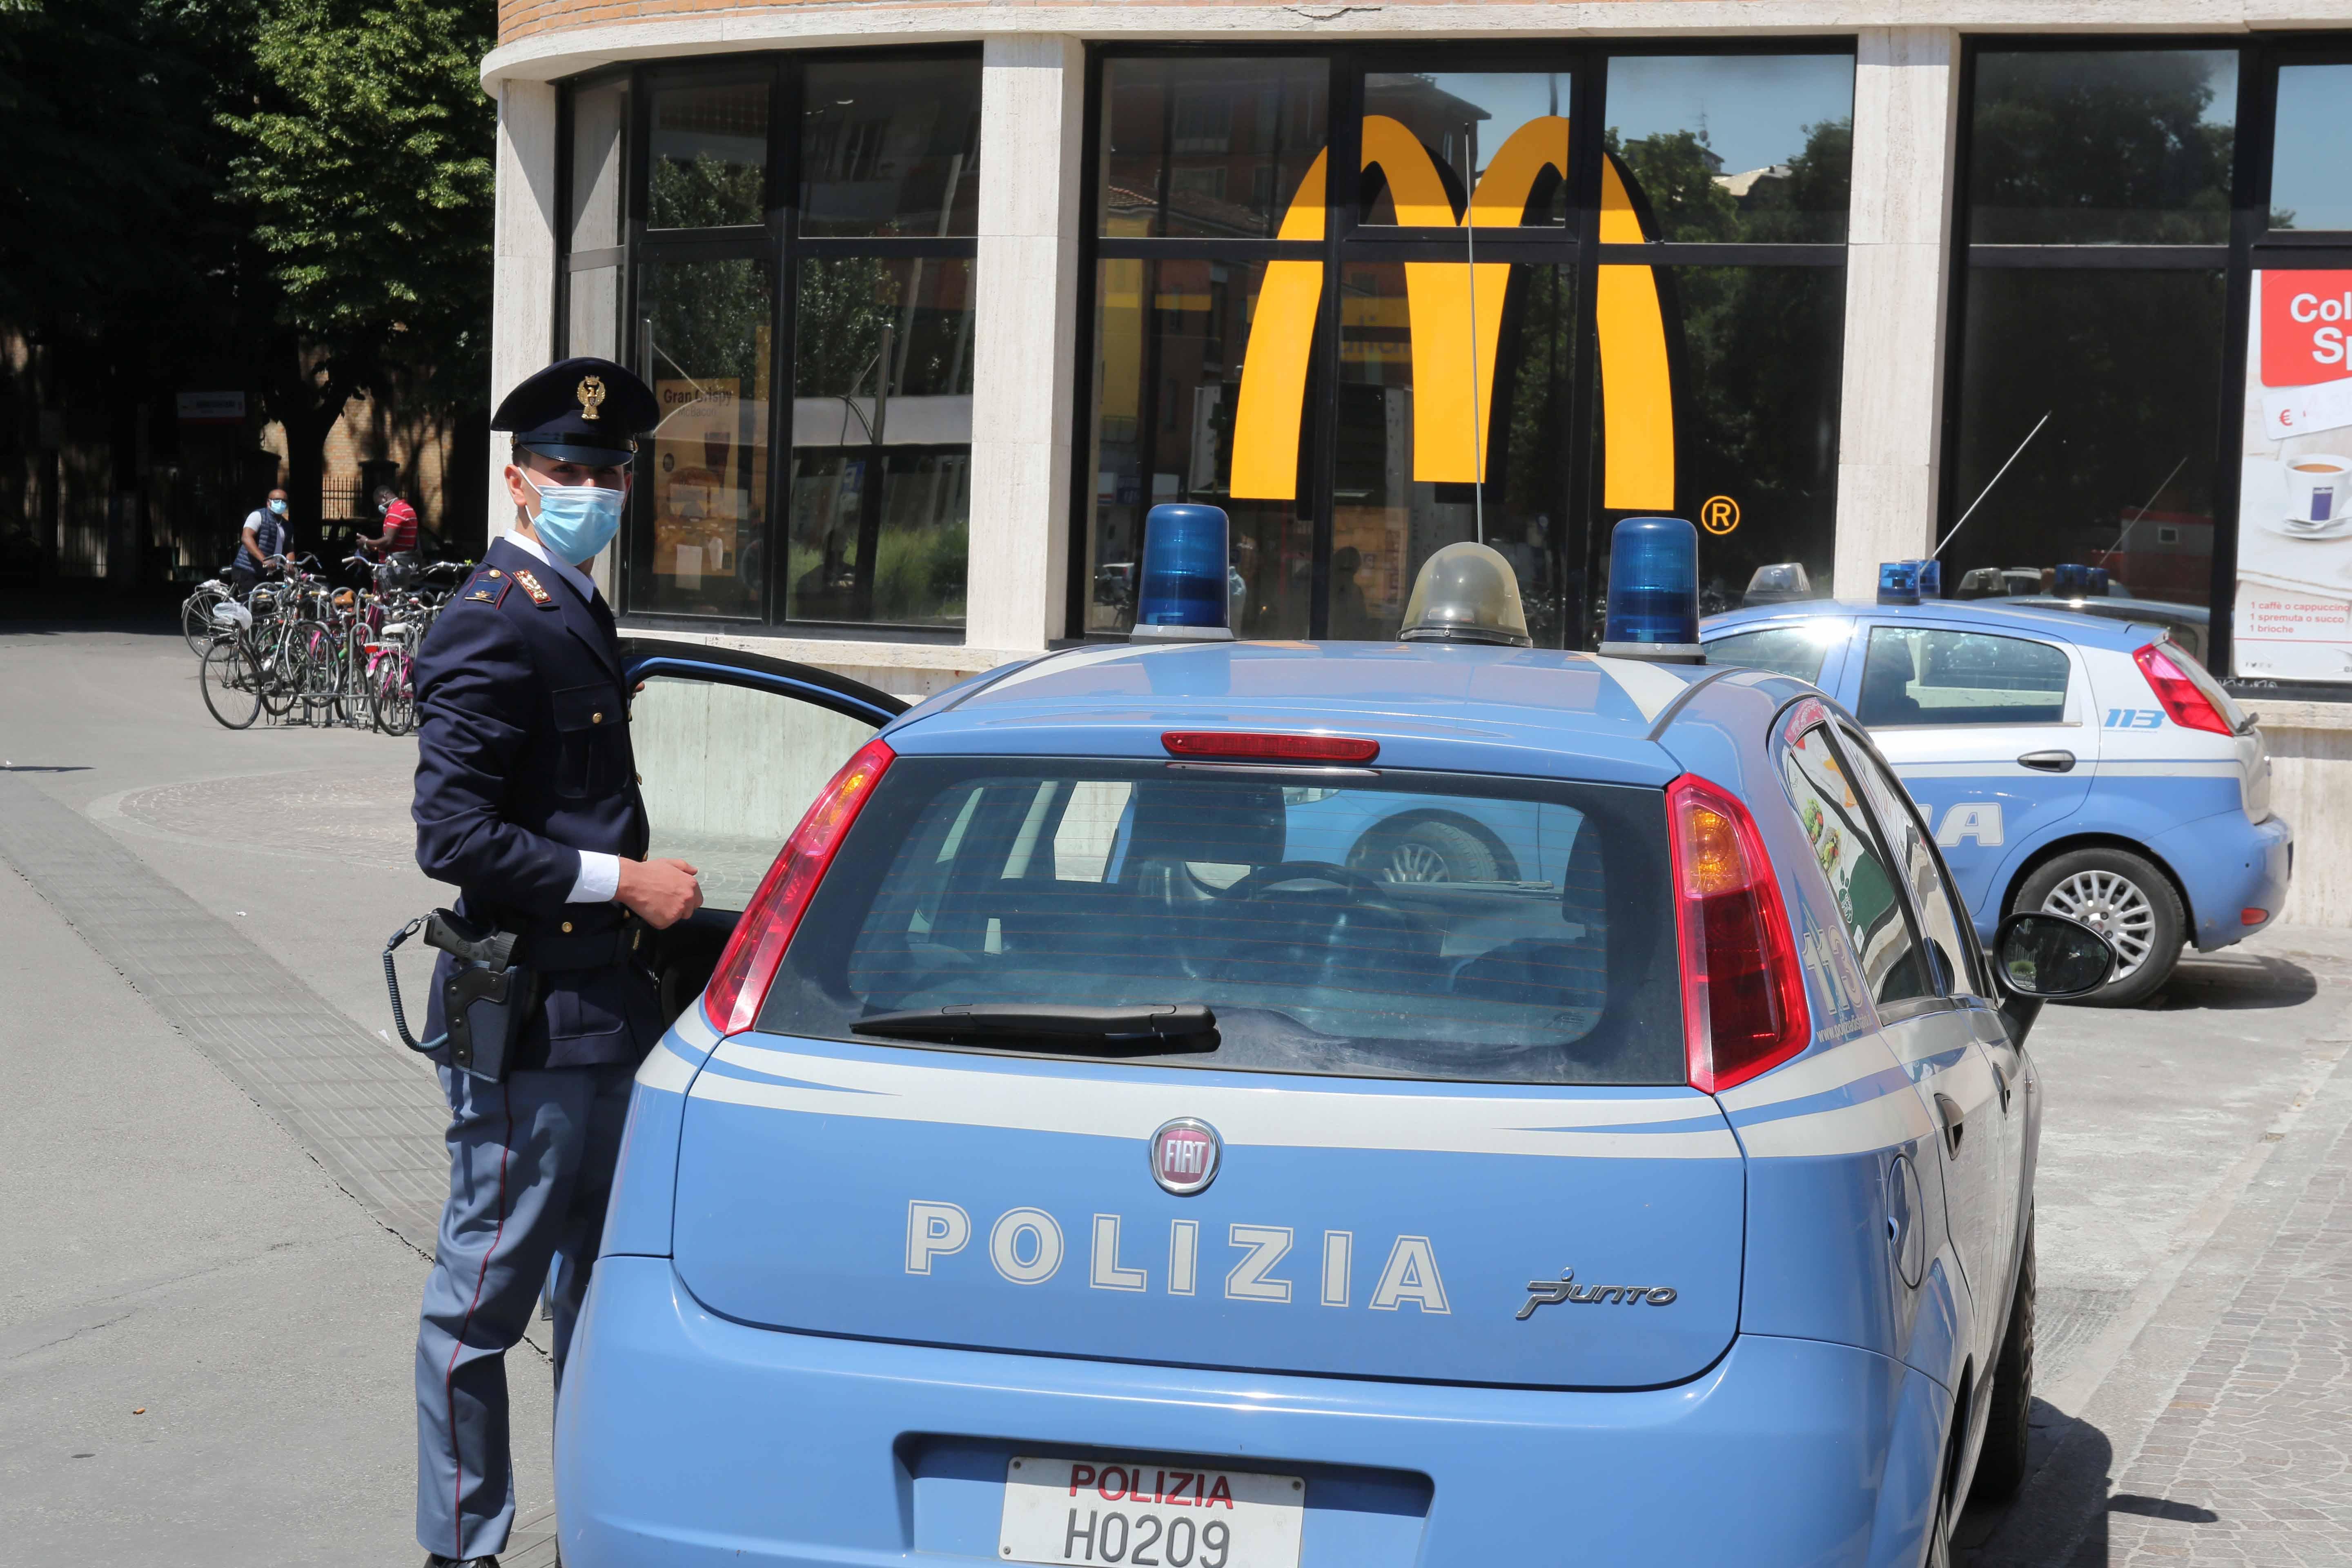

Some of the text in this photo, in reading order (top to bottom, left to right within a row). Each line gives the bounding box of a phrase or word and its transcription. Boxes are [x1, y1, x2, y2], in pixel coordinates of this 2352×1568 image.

[2290, 292, 2352, 323] Col
[2312, 326, 2352, 371] S
[664, 387, 732, 407] Gran Crispy
[2279, 409, 2293, 426] €
[2258, 601, 2282, 609] caffè
[2294, 604, 2350, 612] cappuccino
[2258, 625, 2294, 633] brioche
[2103, 708, 2166, 728] 113
[1916, 802, 2004, 847] A
[1802, 925, 1863, 1015] 113
[1164, 1140, 1206, 1174] FIAT
[904, 1199, 1451, 1315] POLIZIA
[1069, 1465, 1233, 1509] POLIZIA
[1064, 1508, 1231, 1568] H0209
